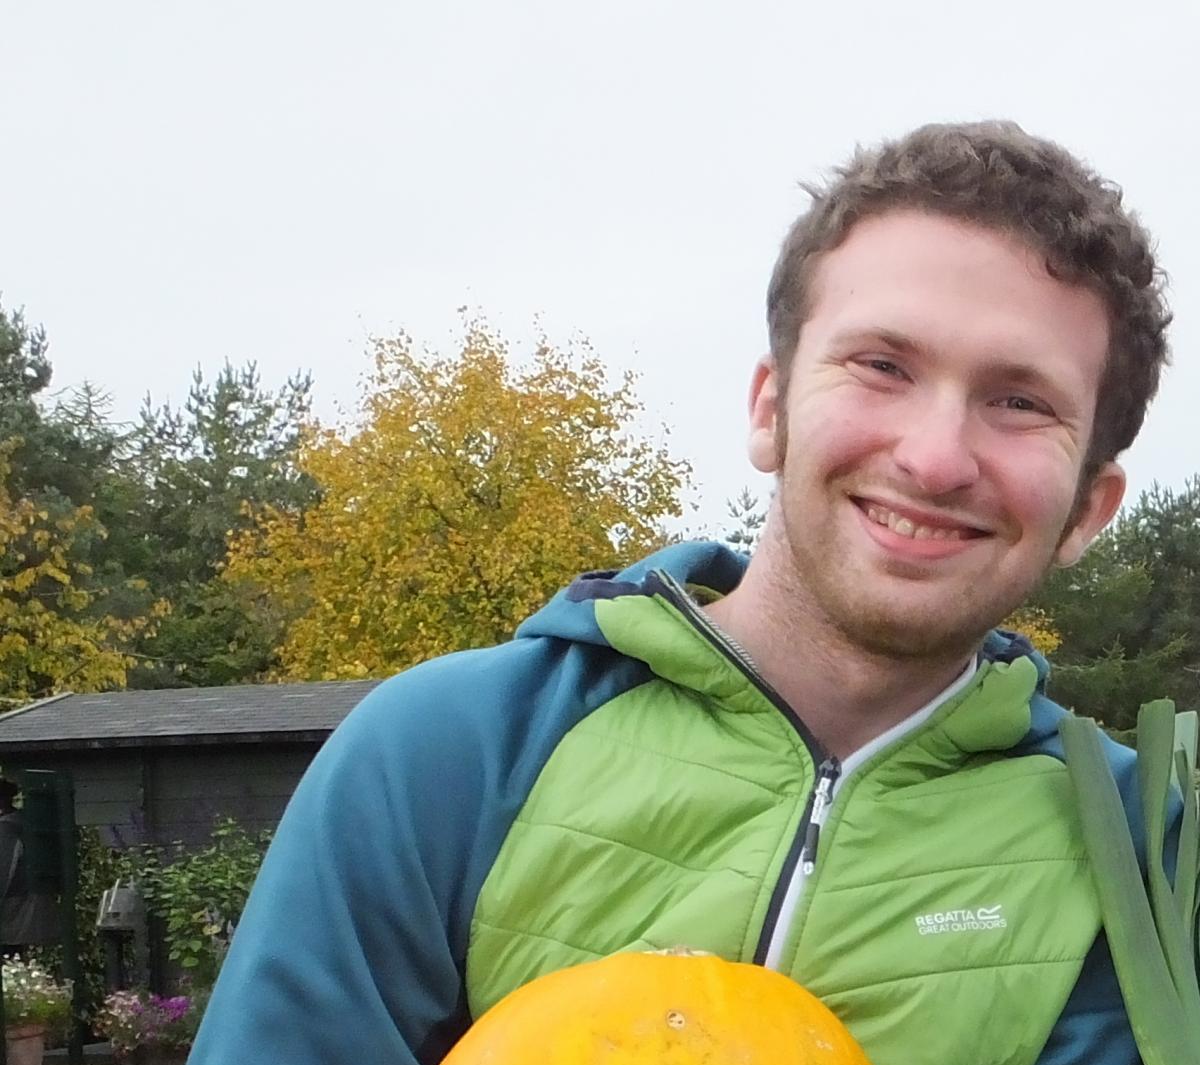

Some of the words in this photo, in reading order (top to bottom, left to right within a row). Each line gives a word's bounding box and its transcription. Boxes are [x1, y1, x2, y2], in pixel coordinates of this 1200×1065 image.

[915, 910, 975, 927] REGATTA
[918, 923, 950, 935] GREAT
[951, 919, 1007, 932] OUTDOORS
